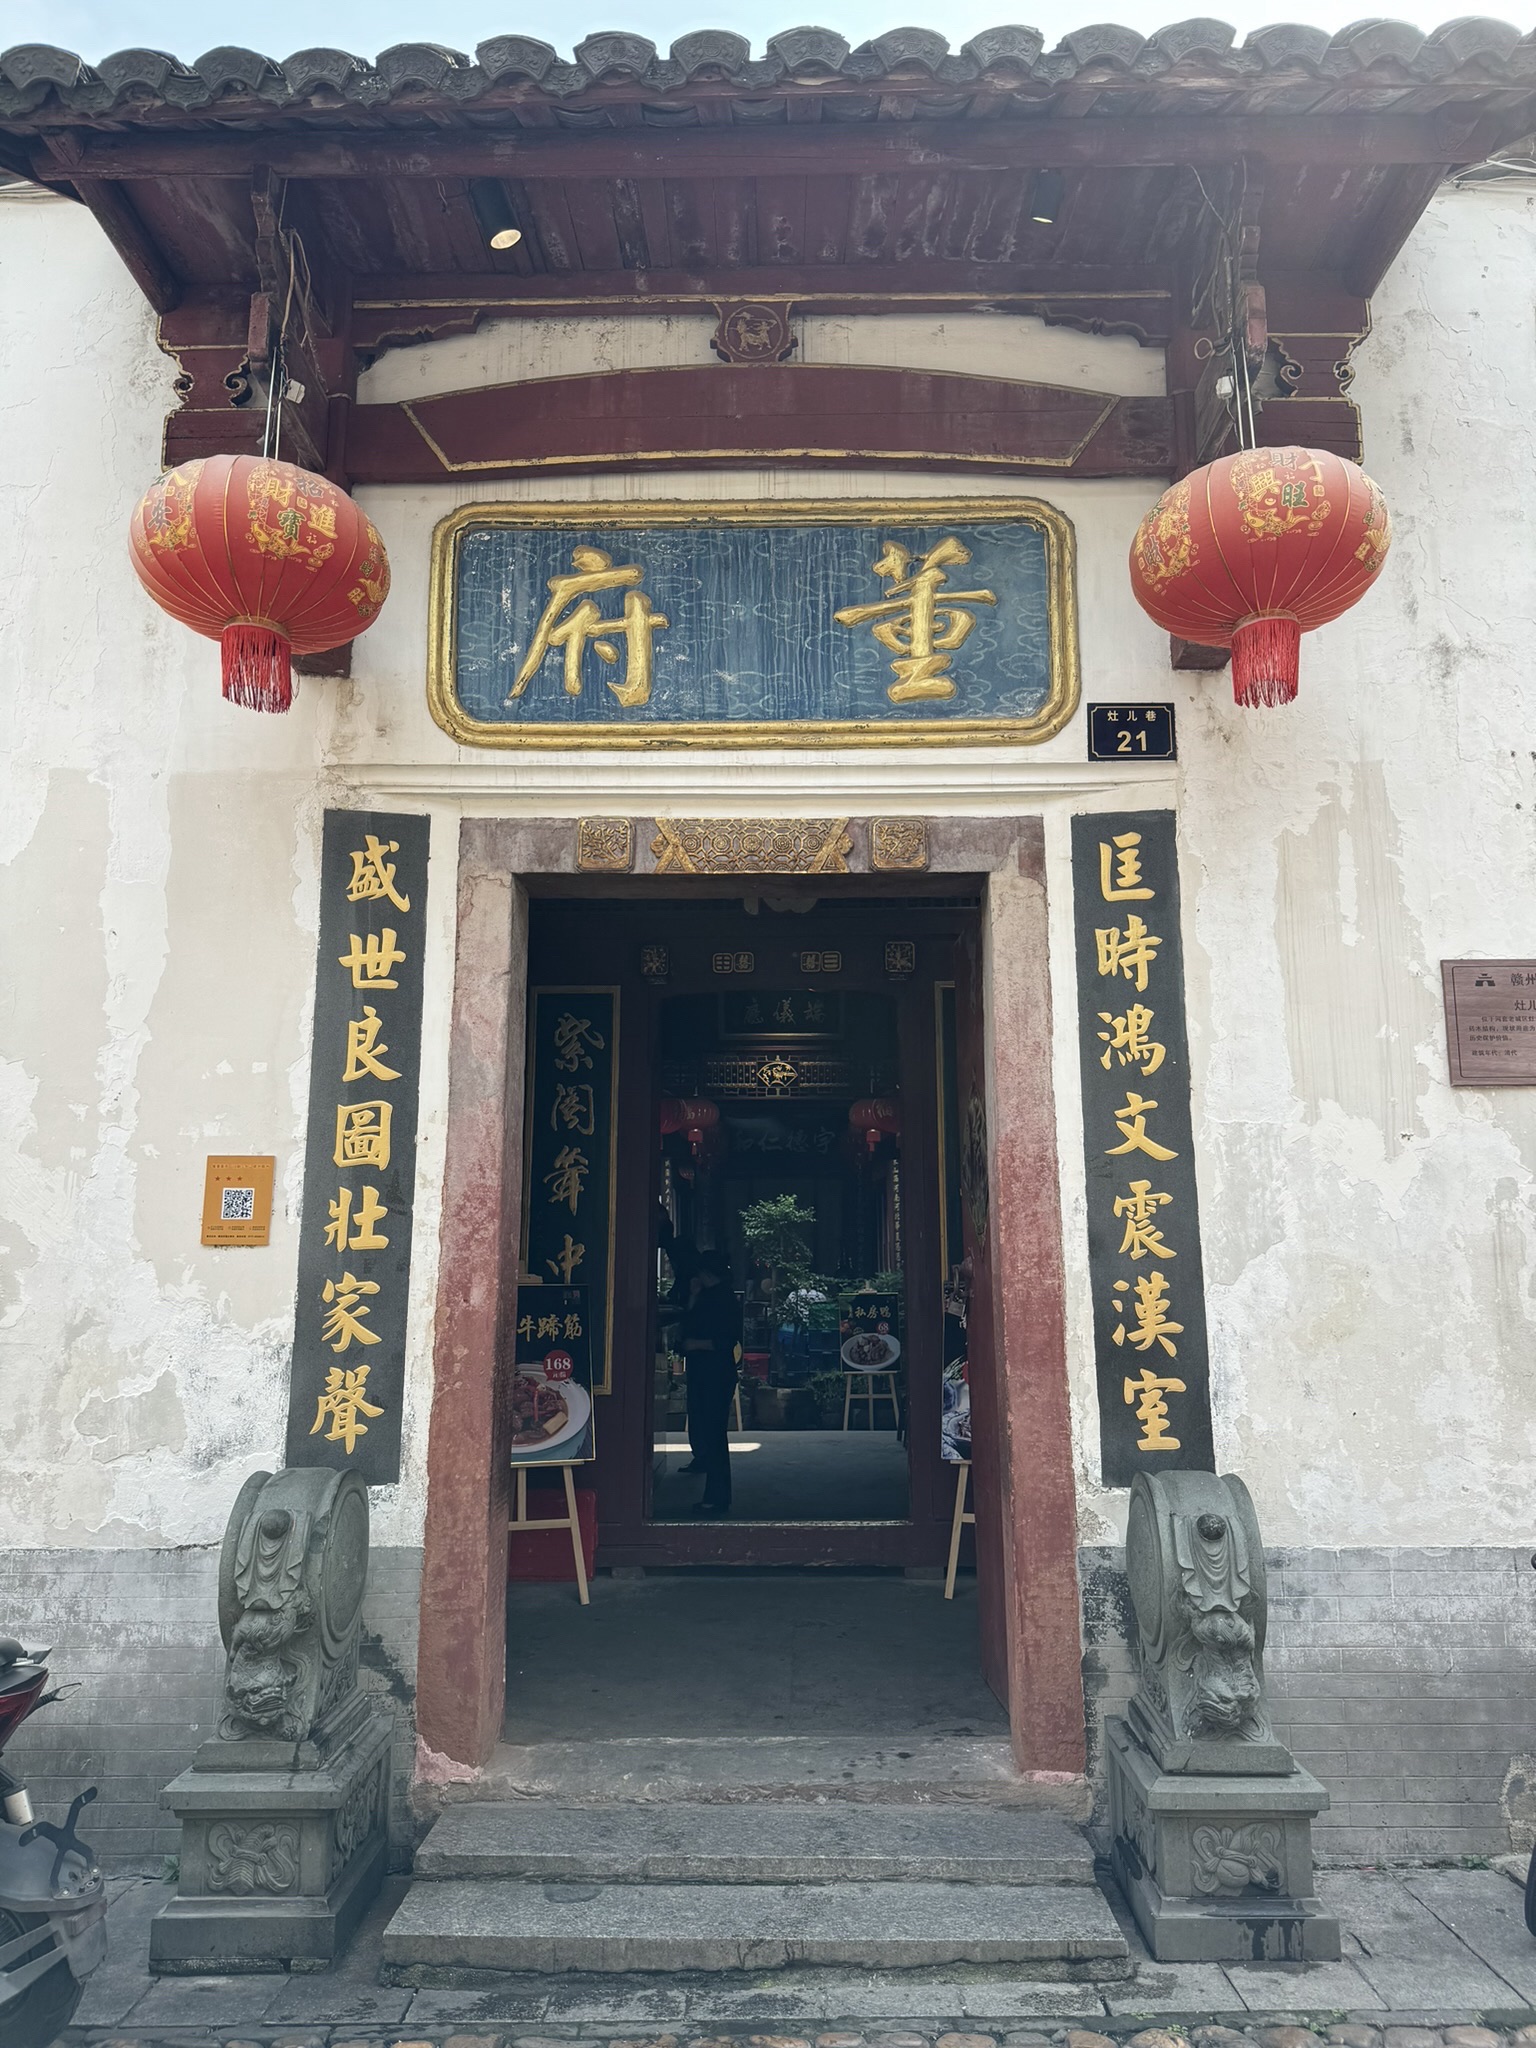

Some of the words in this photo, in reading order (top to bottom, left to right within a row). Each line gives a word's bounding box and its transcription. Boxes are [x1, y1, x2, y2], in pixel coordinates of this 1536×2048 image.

[1107, 710, 1157, 722] 灶儿巷
[1117, 730, 1148, 752] 21
[309, 834, 412, 1455] 盛世良圖壯家聲
[1094, 831, 1188, 1452] 匡時鴻文震漢室
[517, 1313, 583, 1342] 牛蹄筋
[877, 1322, 889, 1331] 68
[545, 1357, 572, 1371] 168
